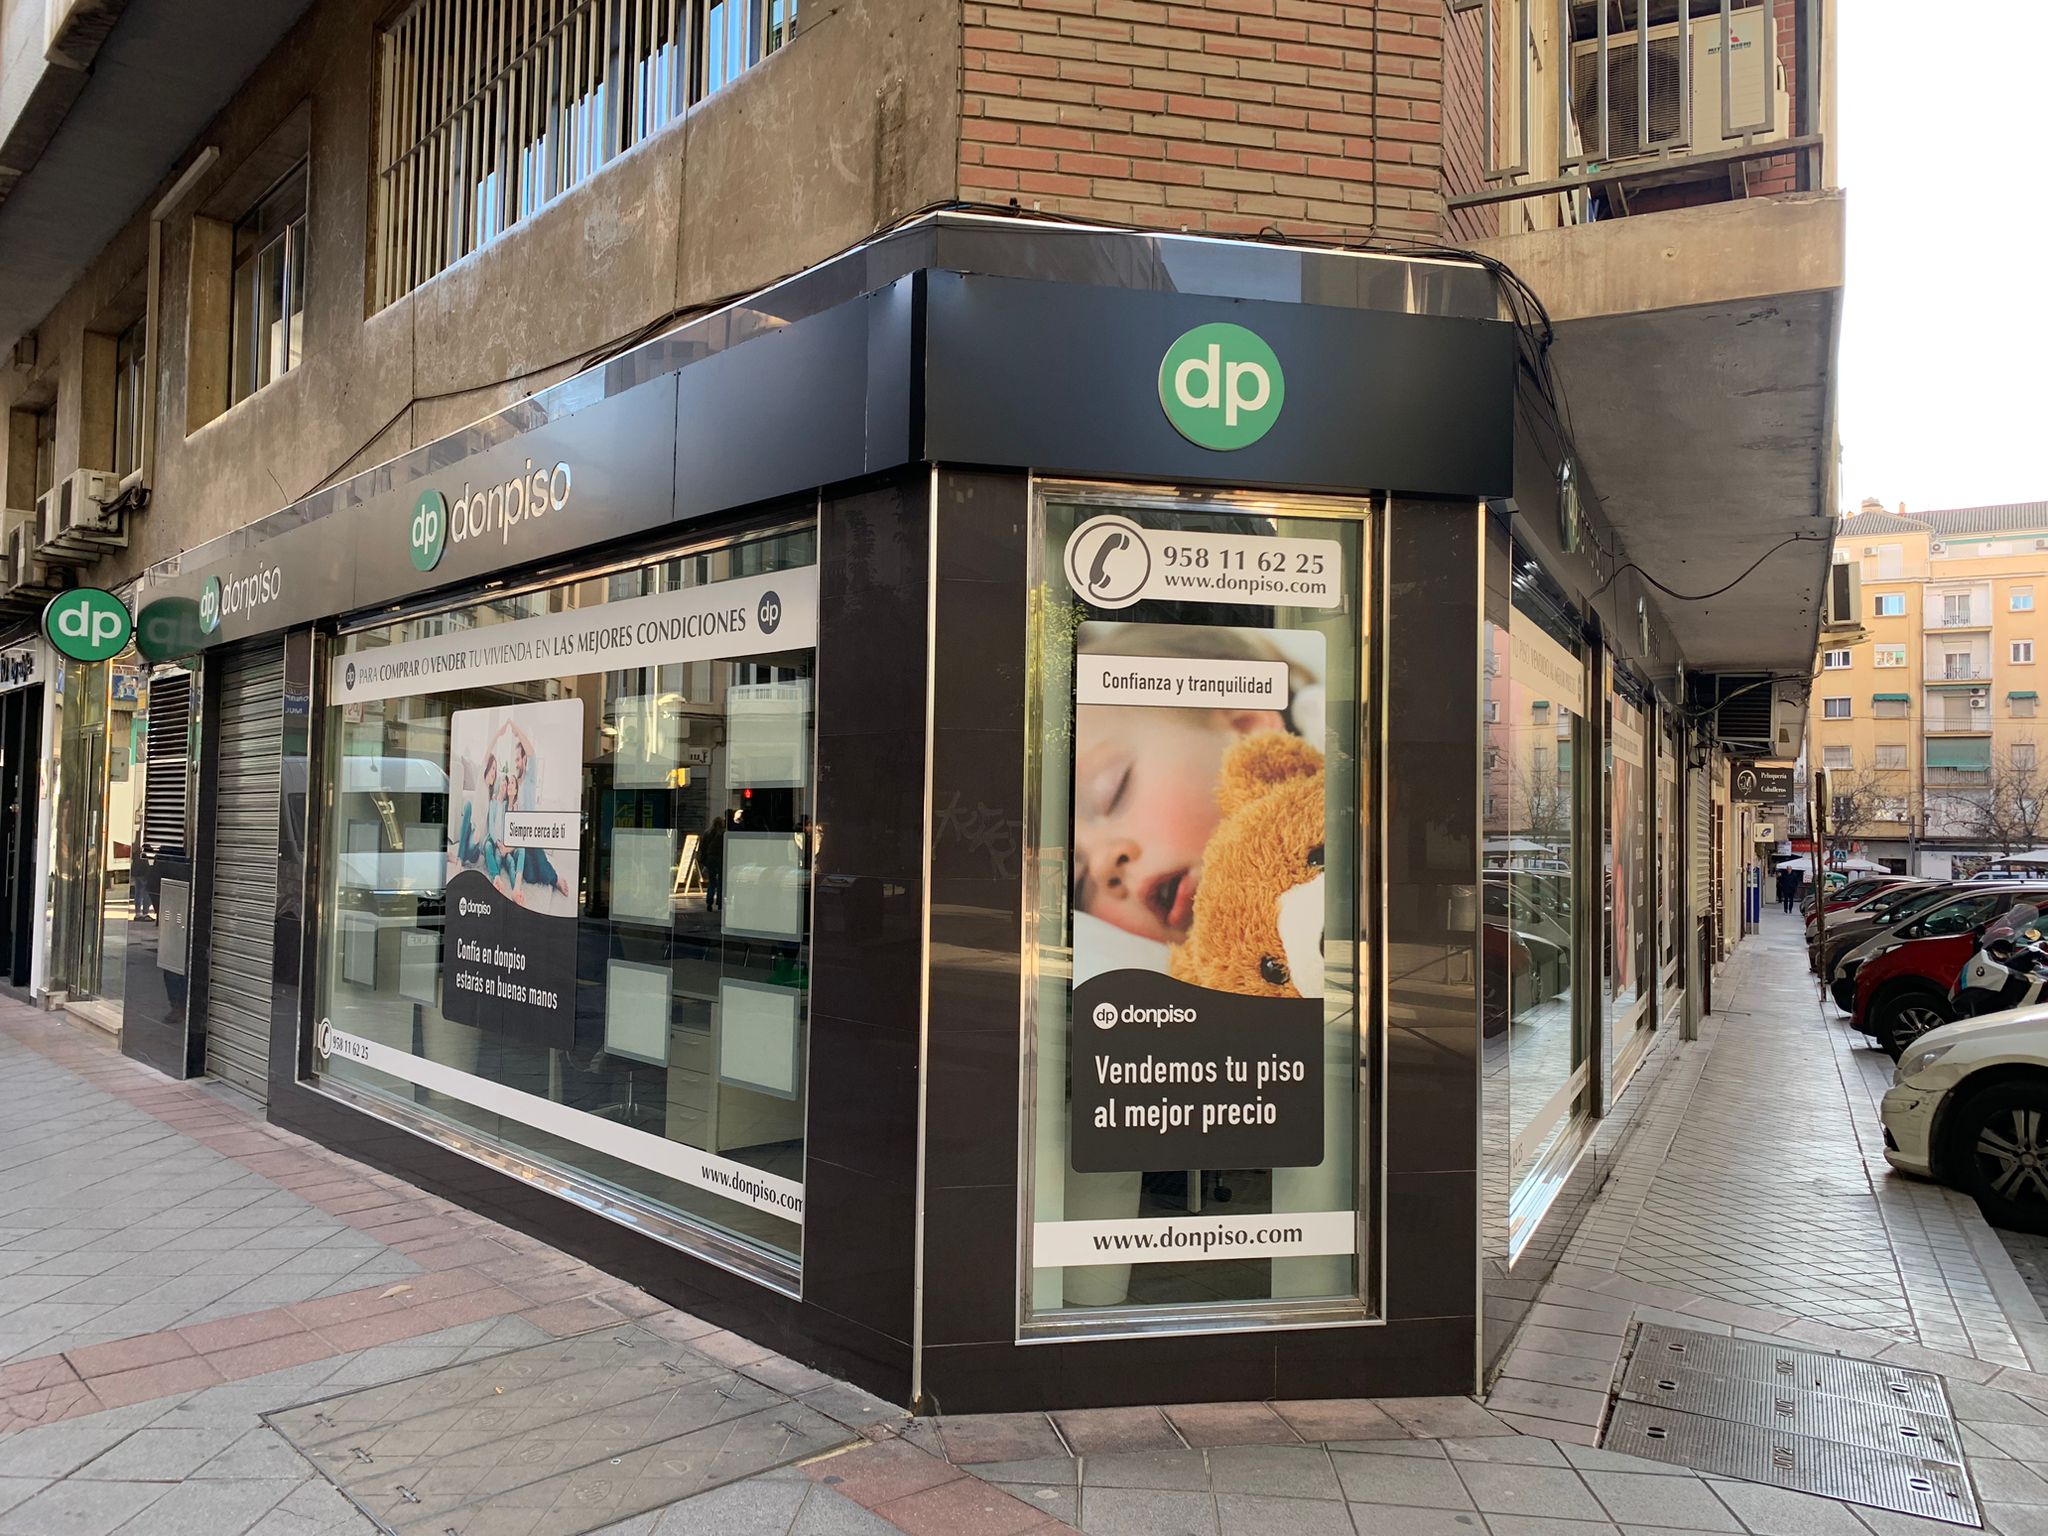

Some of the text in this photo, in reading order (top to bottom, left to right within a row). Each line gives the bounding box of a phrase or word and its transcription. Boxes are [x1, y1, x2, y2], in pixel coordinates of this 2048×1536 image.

[1174, 343, 1271, 426] dp
[412, 457, 571, 555] dp donpiso
[1163, 545, 1325, 576] 958 11 62 25
[200, 561, 281, 623] dp donpiso
[1164, 573, 1327, 595] www.donpiso.com
[58, 601, 122, 647] dp
[359, 667, 378, 684] PARA
[380, 659, 420, 681] COMPRAR
[421, 657, 429, 675] O
[431, 652, 466, 673] VENDER
[469, 649, 482, 668] TU
[483, 642, 533, 666] VIVIENDA
[536, 638, 550, 659] EN
[554, 634, 574, 656] LAS
[577, 625, 633, 655] MEJORES
[636, 607, 746, 645] CONDICIONES
[760, 600, 779, 626] dp
[1102, 670, 1273, 697] Confianza y tranquilidad
[509, 822, 566, 841] Siempre cerca de ti
[467, 899, 492, 918] donpiso
[457, 938, 480, 963] Confía
[482, 947, 492, 964] en
[494, 944, 526, 974] donpiso
[456, 971, 558, 1010] estarás en buenas manos
[1096, 1004, 1197, 1028] dp donpiso
[332, 1035, 369, 1060] 958 11 62 25
[1094, 1053, 1305, 1090] Vendemos tu piso
[1094, 1096, 1277, 1134] al mejor precio
[1093, 1224, 1304, 1253] www.donpiso.com
